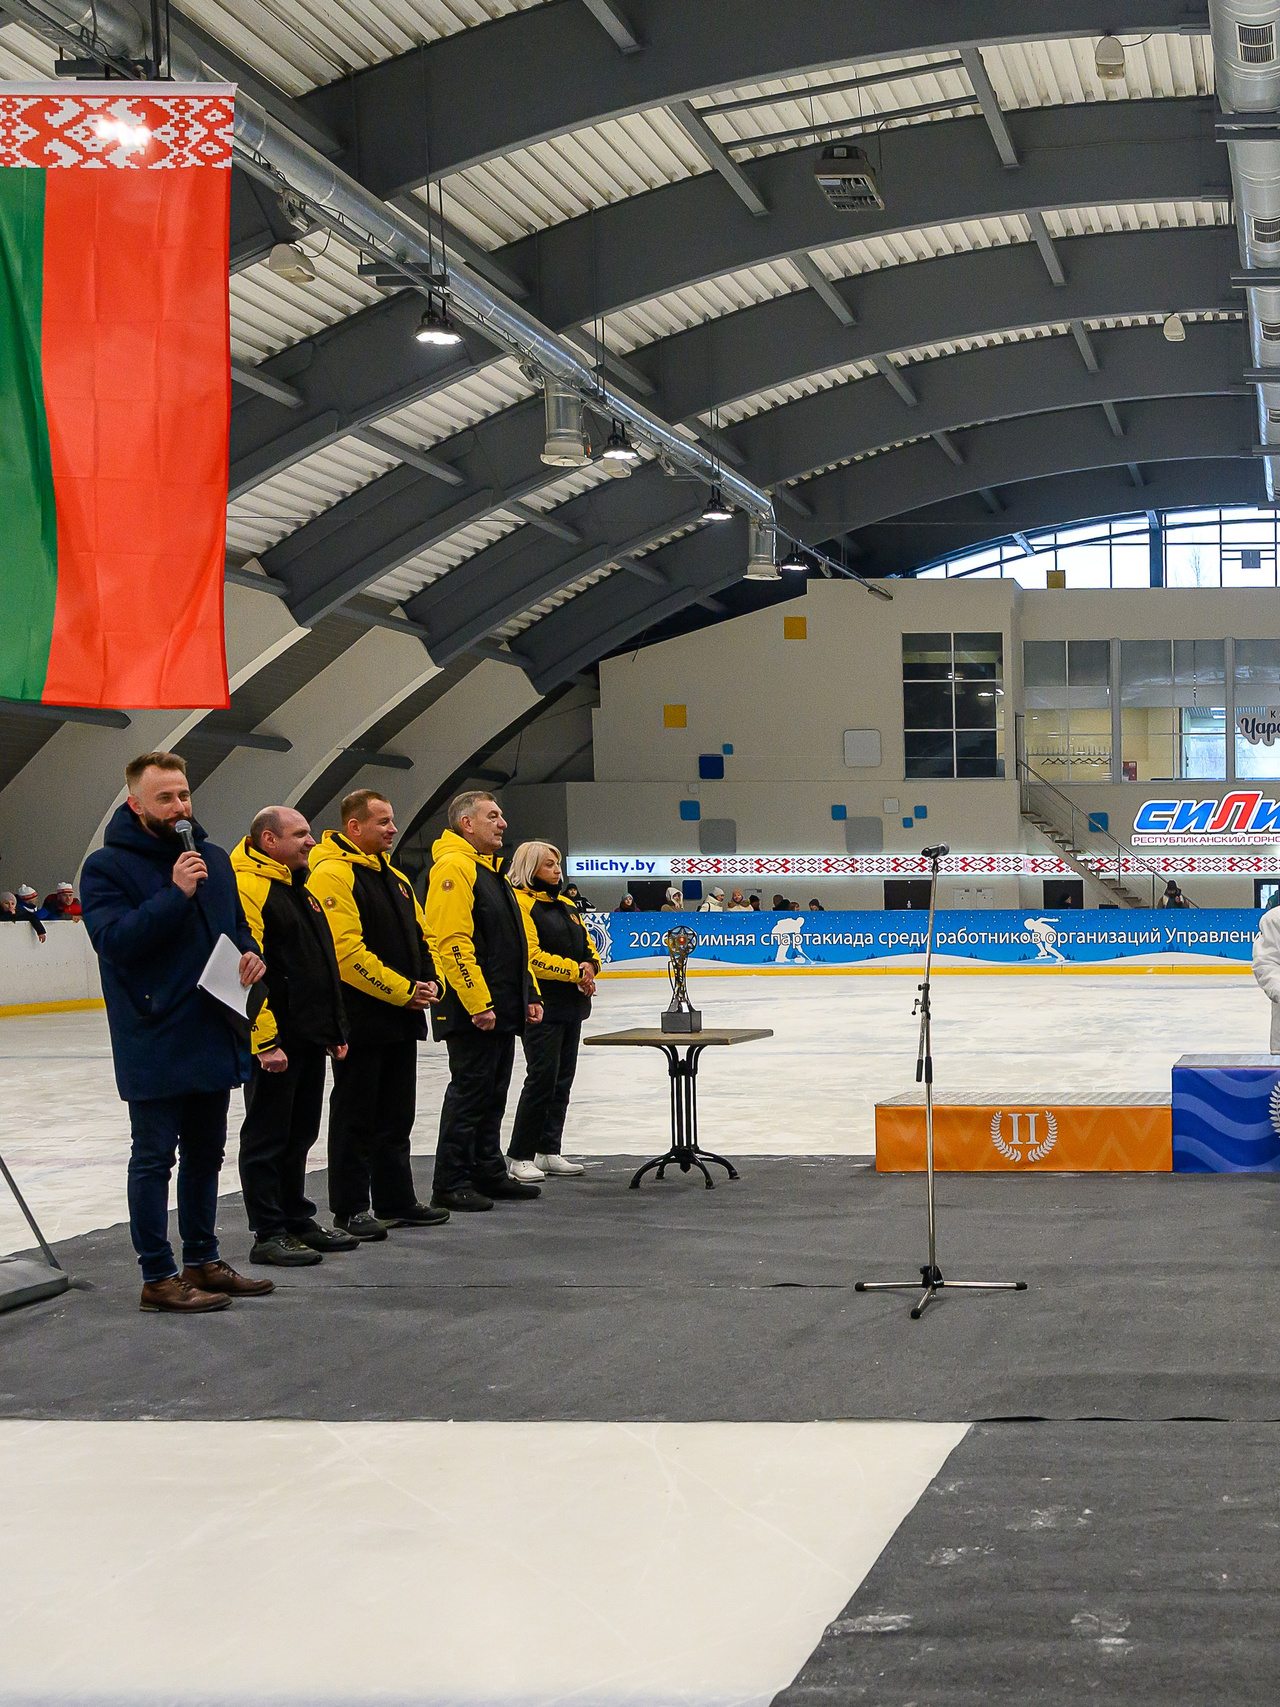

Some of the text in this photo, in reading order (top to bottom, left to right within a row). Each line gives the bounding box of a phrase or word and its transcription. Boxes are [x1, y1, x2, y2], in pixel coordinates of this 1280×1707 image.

[1133, 833, 1246, 844] РЕСПУБЛИКАНСКИЙ
[576, 859, 656, 873] silichy.by
[696, 933, 756, 946] имняя
[760, 932, 874, 949] спартакиада
[878, 932, 929, 949] среди
[936, 926, 1042, 948] работников
[1045, 927, 1161, 948] организаций
[1165, 927, 1262, 947] Управлени
[353, 962, 393, 995] BELARUS
[452, 945, 474, 989] BELARUS
[531, 958, 572, 976] BELARUS
[1007, 1113, 1040, 1145] II
